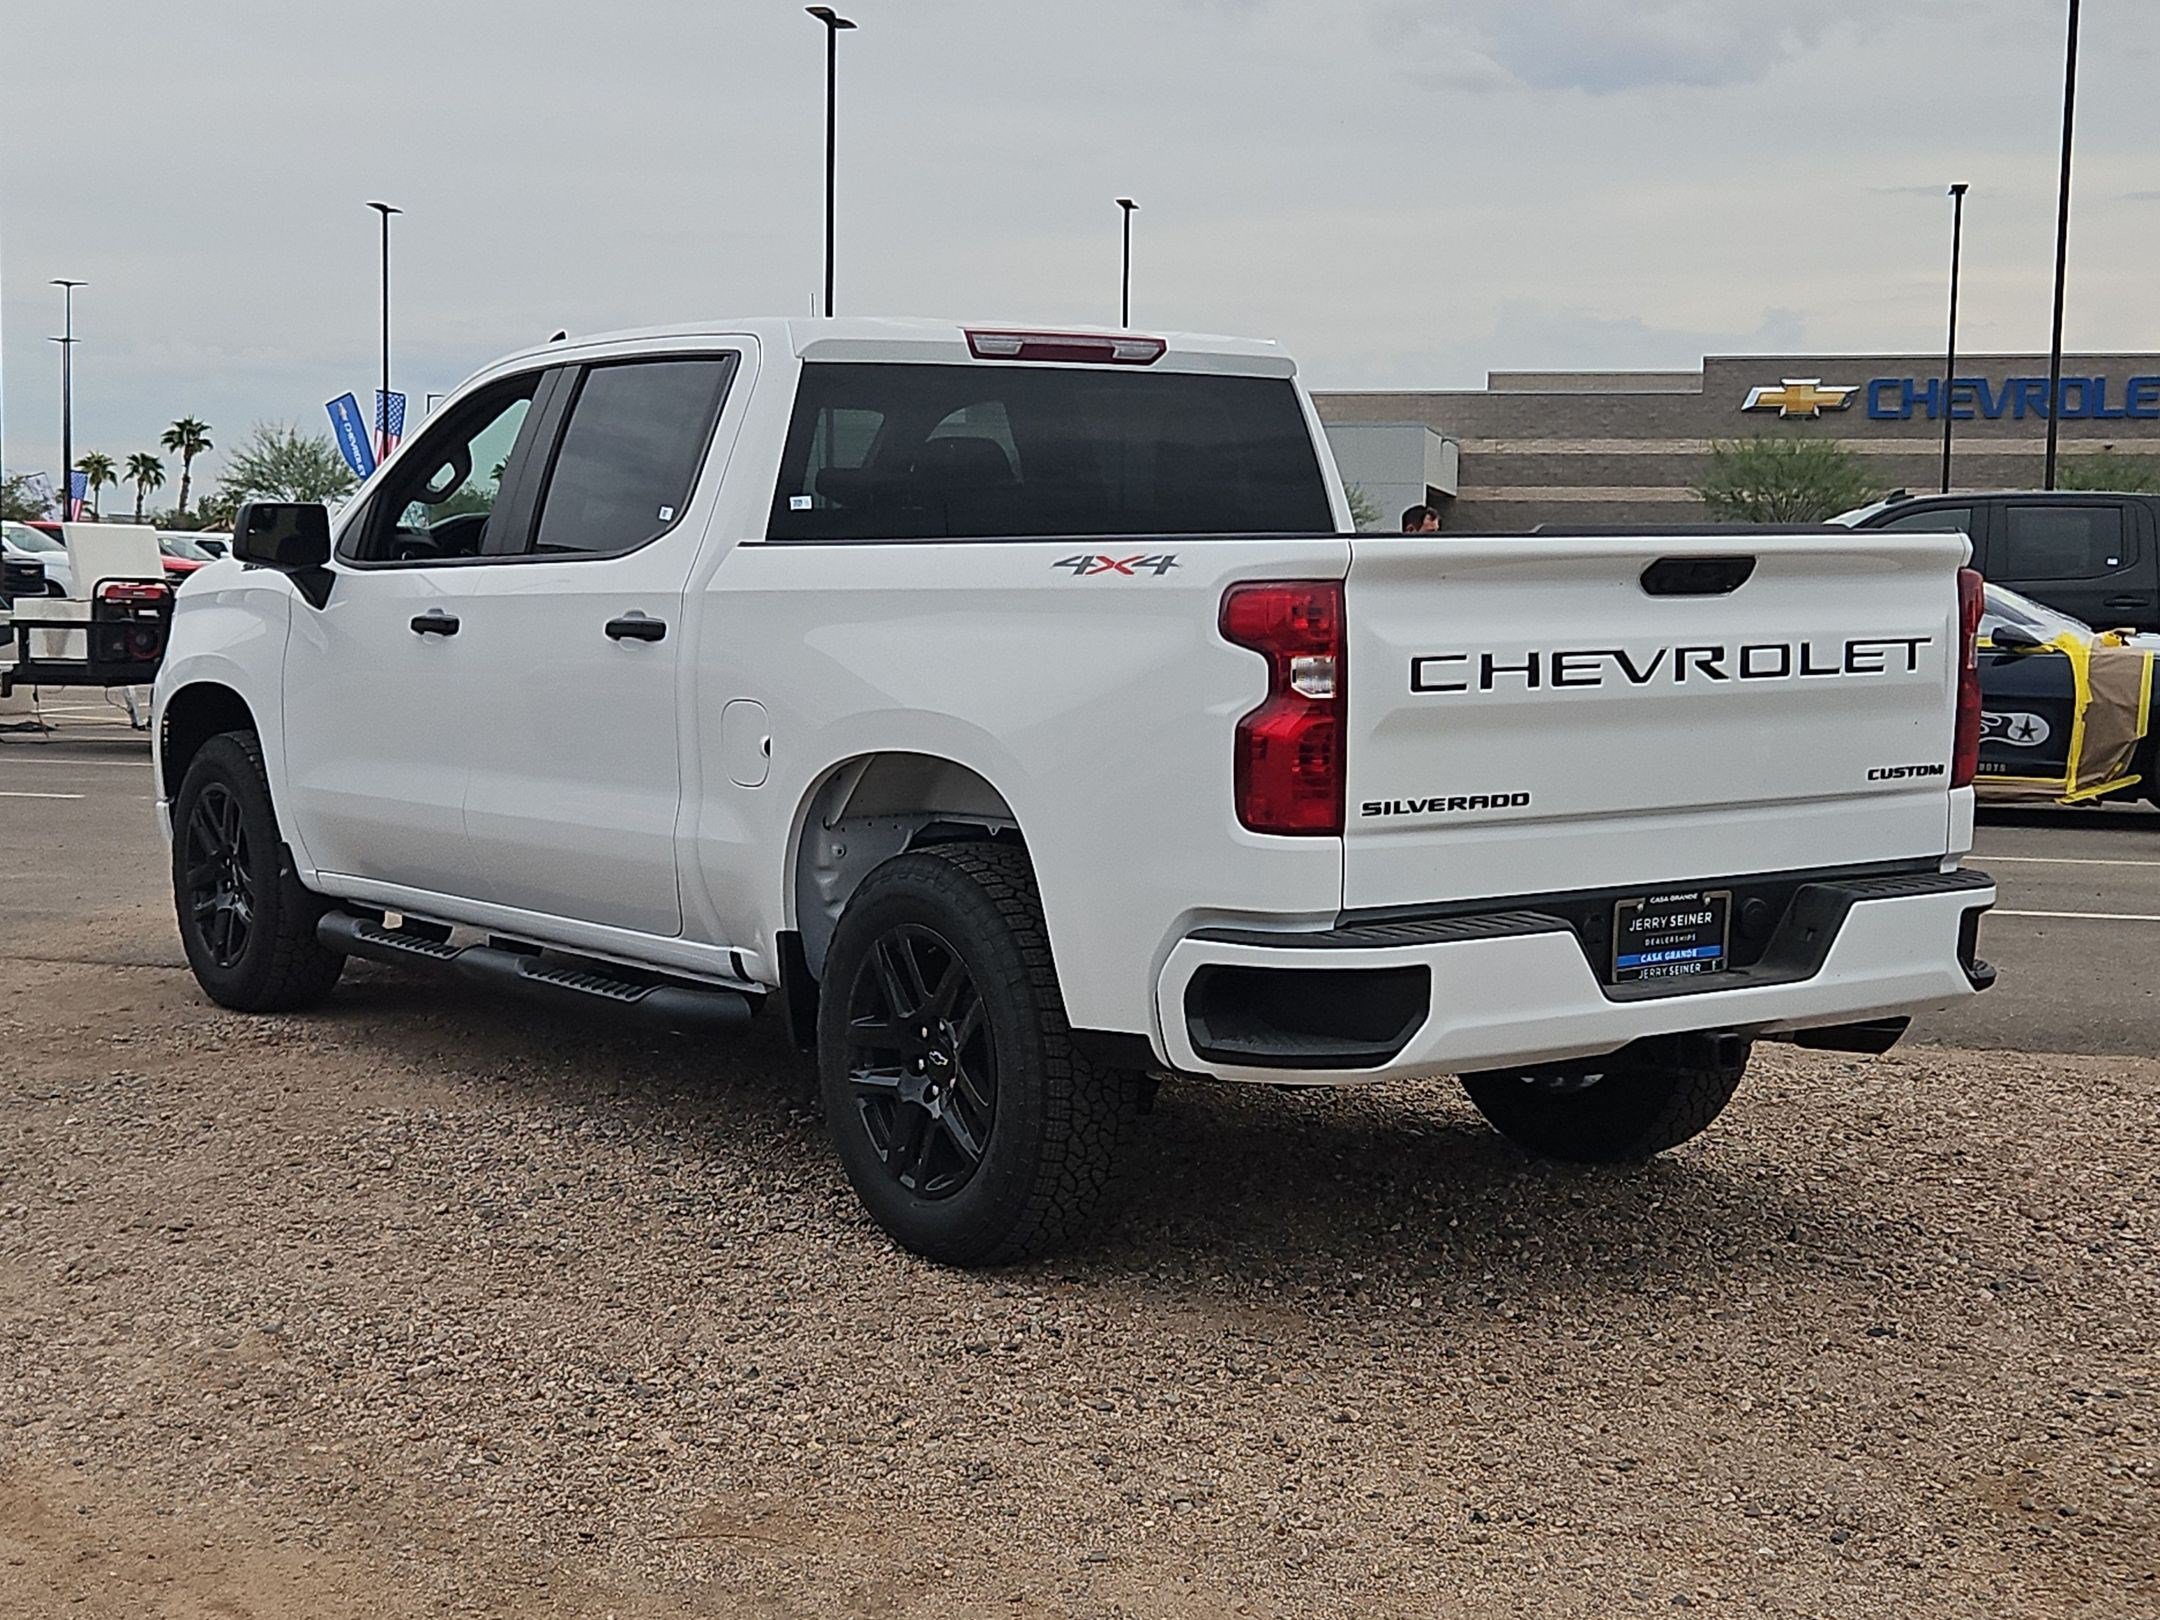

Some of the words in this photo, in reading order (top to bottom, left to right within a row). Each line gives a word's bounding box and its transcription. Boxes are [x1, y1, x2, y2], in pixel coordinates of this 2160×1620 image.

[1410, 637, 1932, 693] CHEVROLET
[1867, 764, 1945, 781] CUSTOM
[1361, 792, 1530, 817] SILVERADO
[1669, 893, 1698, 901] GRANDE
[1629, 916, 1667, 932] JERRY
[1669, 912, 1712, 927] SEINER
[1644, 934, 1696, 946] DEALERSHIPS
[1640, 953, 1663, 963] CASA
[1664, 948, 1698, 960] GRANDE
[1638, 967, 1667, 979] JERRY
[1669, 963, 1701, 976] SEINER
